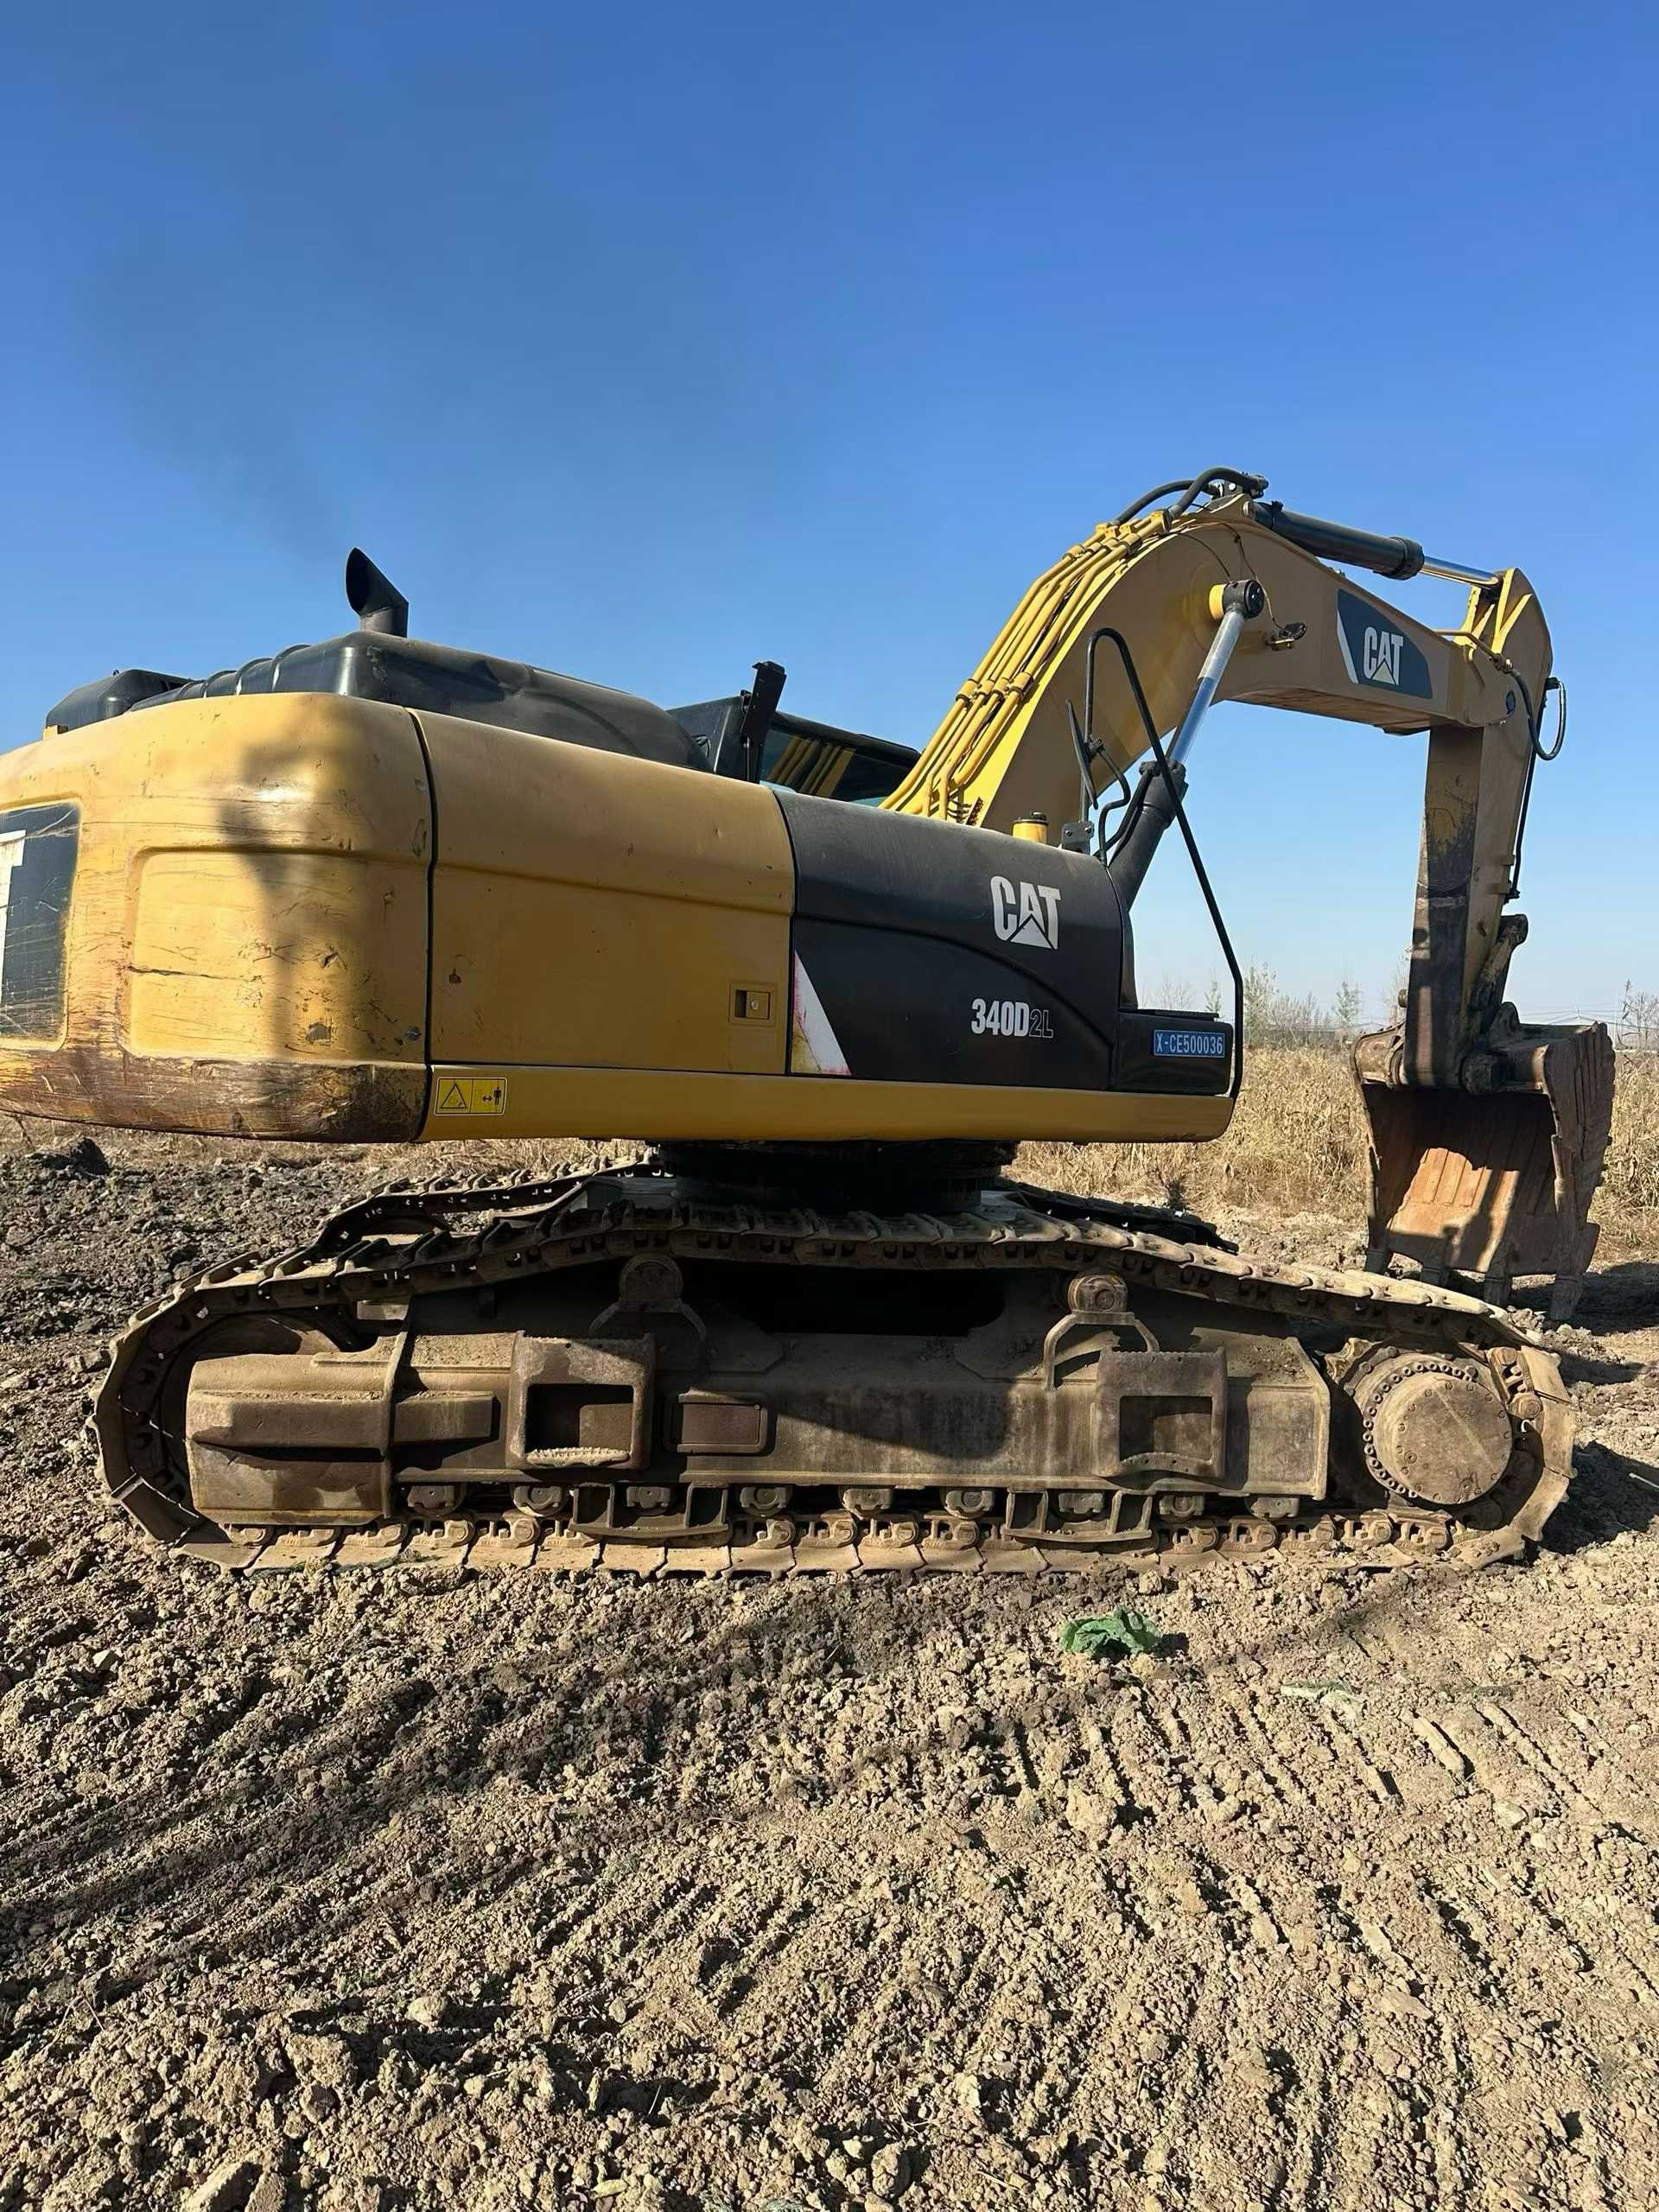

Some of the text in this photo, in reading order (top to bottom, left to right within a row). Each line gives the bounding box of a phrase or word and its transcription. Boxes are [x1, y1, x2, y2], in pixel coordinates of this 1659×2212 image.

[1363, 626, 1404, 685] CAT
[990, 875, 1062, 950] CAT
[971, 998, 1054, 1039] 340D2L
[1156, 1033, 1224, 1054] X-CE500036
